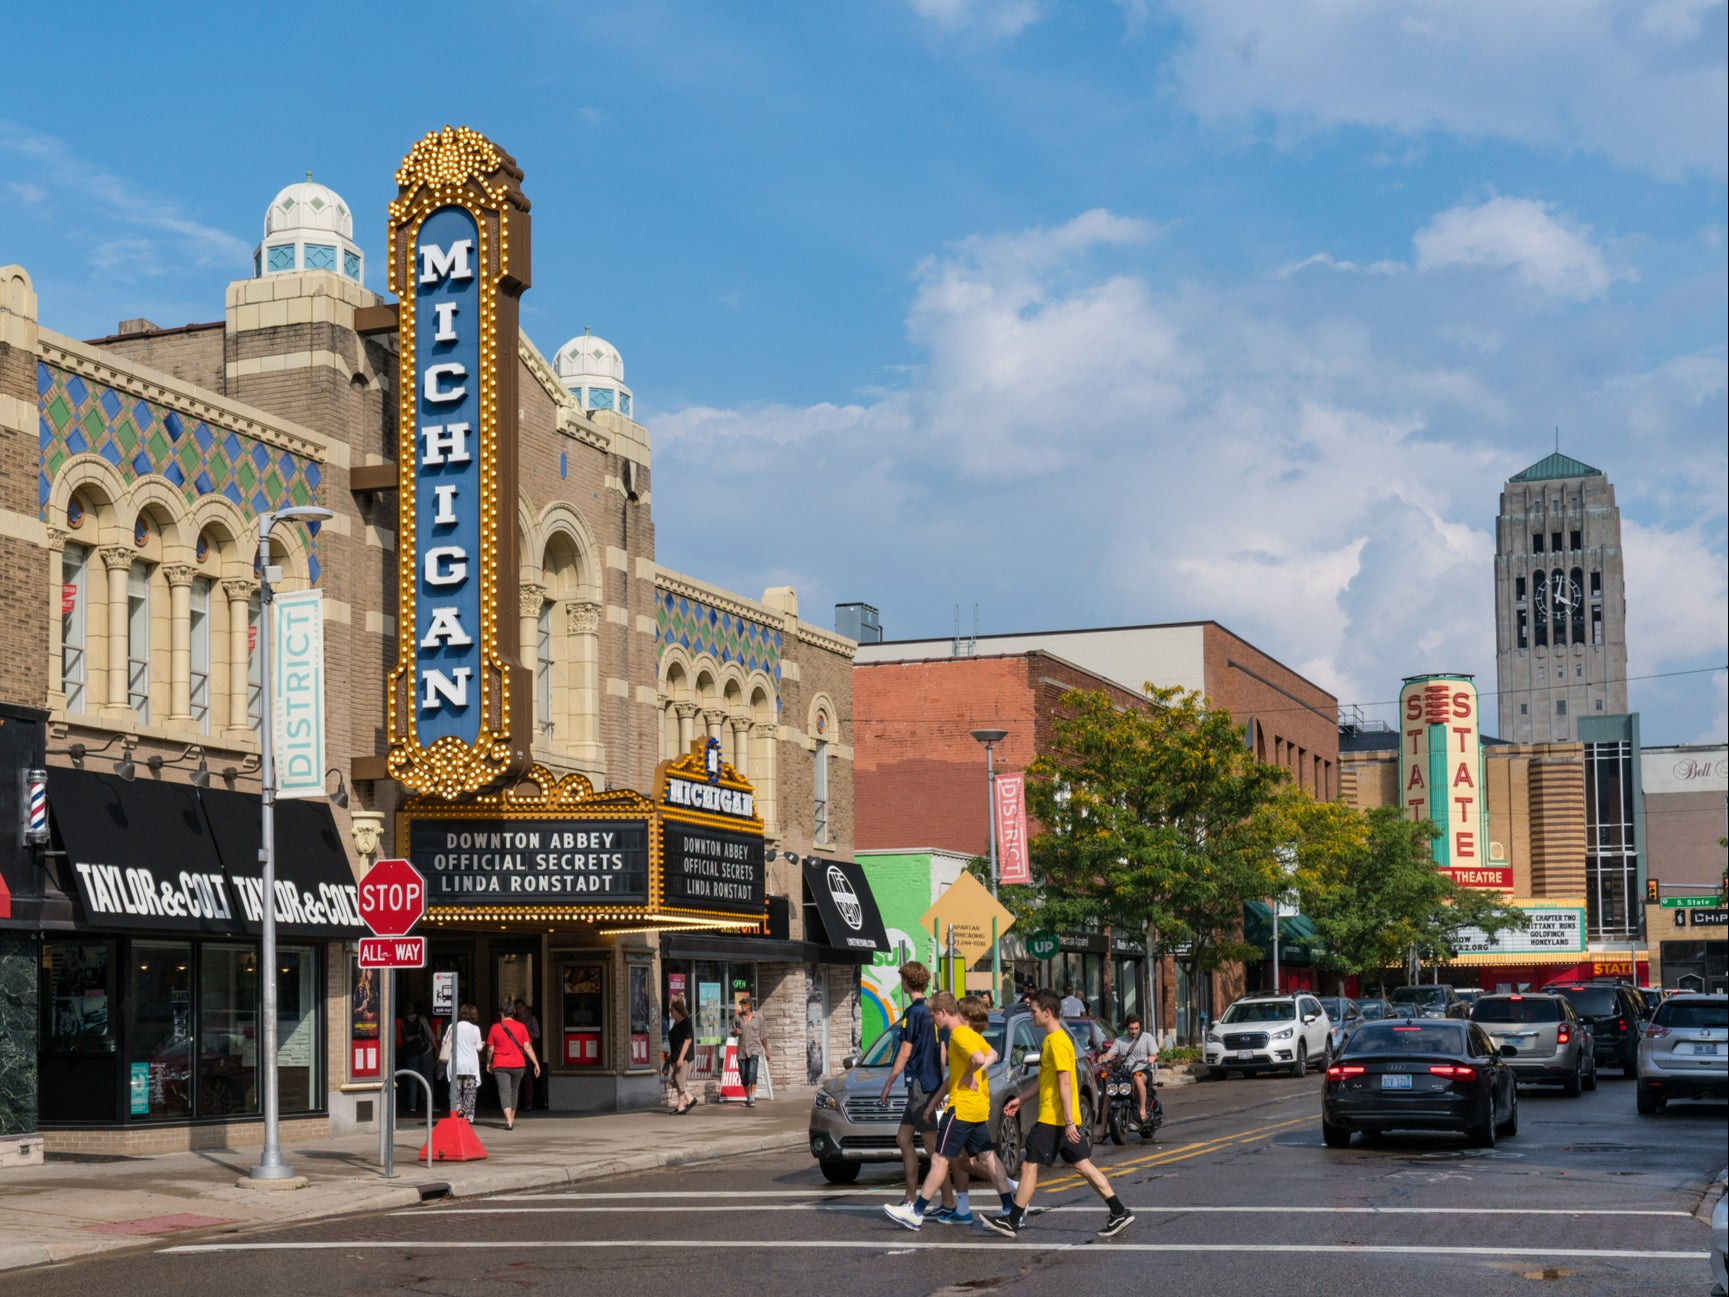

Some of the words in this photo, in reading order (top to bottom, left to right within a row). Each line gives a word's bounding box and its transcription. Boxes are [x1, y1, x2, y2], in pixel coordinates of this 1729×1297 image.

[419, 239, 473, 708] MICHIGAN
[286, 612, 312, 777] DISTRICT
[1406, 694, 1425, 849] STAT
[1452, 692, 1475, 857] STATE
[1673, 758, 1711, 780] Bell
[669, 778, 753, 817] MICHIGAN
[1002, 784, 1021, 873] DISTRICT
[447, 832, 540, 849] DOWNTON
[550, 832, 614, 849] ABBEY
[683, 836, 721, 856] DOWNTON
[724, 841, 748, 860] ABBEY
[434, 854, 526, 871] OFFICIAL
[536, 854, 622, 871] SECRETS
[683, 857, 718, 877] OFFICIAL
[722, 862, 753, 880] SECRETS
[441, 875, 500, 892] LINDA
[511, 875, 612, 892] RONSTADT
[1454, 871, 1502, 884] THEATRE
[362, 884, 420, 912] STOP
[687, 878, 710, 896] LINDA
[713, 882, 752, 900] RONSTADT
[1535, 914, 1562, 922] CHAPTER
[1563, 914, 1577, 922] TWO
[1559, 922, 1576, 930] RUNS
[362, 944, 385, 961] ALL
[395, 943, 420, 961] WAY
[1034, 941, 1054, 953] UP
